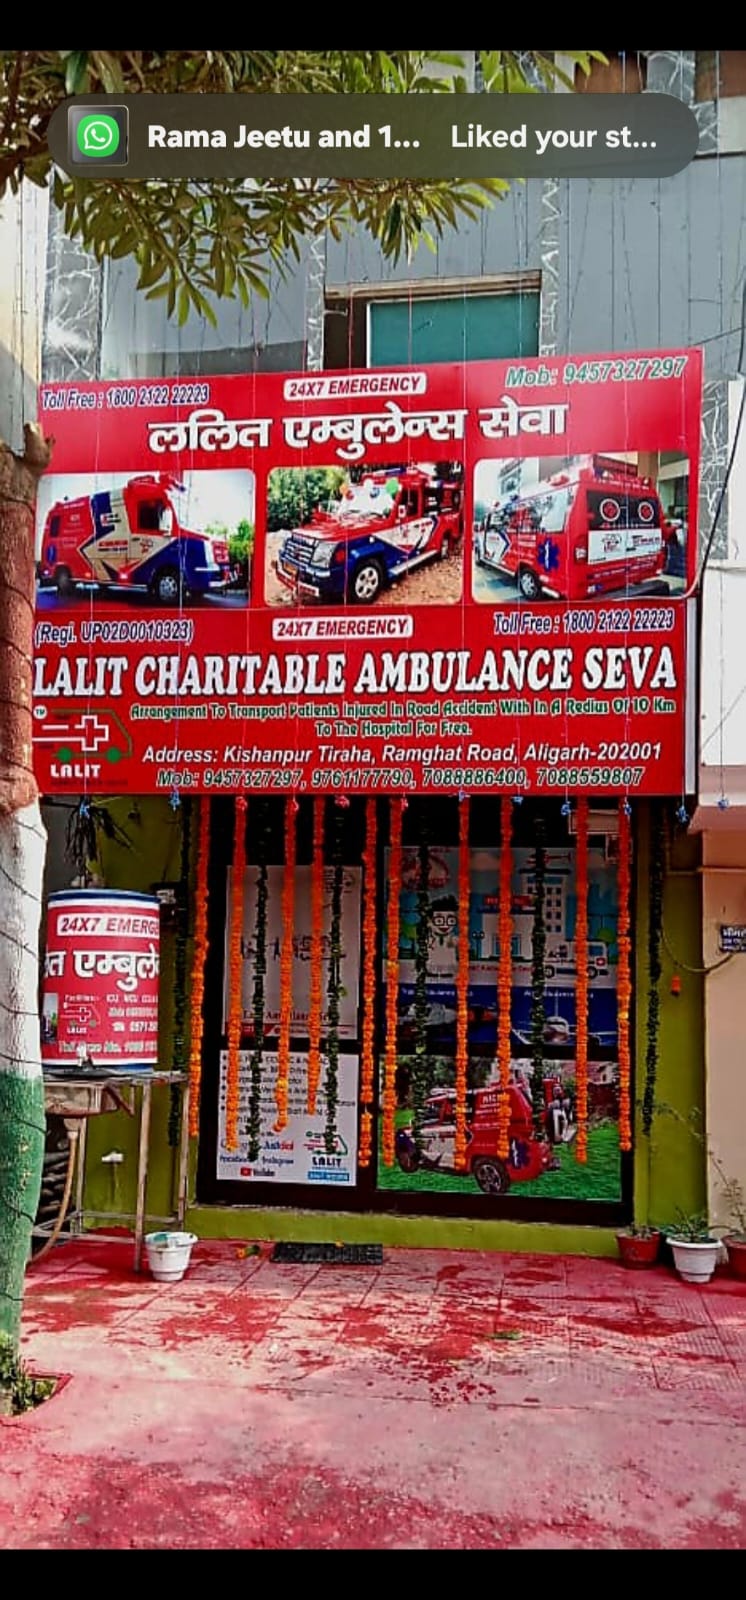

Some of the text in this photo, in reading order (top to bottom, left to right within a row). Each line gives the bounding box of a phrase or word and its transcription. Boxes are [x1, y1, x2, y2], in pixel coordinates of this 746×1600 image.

[505, 357, 687, 388] Mob: 9457327297
[42, 391, 65, 409] Toll
[68, 391, 96, 407] Free
[107, 388, 137, 407] 1800
[139, 387, 170, 406] 2122
[172, 385, 209, 404] 22223
[289, 376, 421, 397] 24X7 EMERGENCY
[148, 395, 569, 460] ललित एम्बुलेन्स सेवा
[277, 617, 408, 638] 24X7 EMERGENCY
[494, 613, 520, 632] Toll
[520, 612, 550, 632] Free
[563, 612, 593, 631] 1800
[597, 610, 630, 630] 2122
[633, 609, 675, 630] 22223
[32, 645, 677, 697] LALIT CHARITABLE AMBULANCE SEVA
[130, 698, 676, 721] Arrangement To Transport Patients Injured In Road Accident With In A Redius Of 10 Km
[315, 721, 473, 738] To The Hospital For Free.
[142, 742, 662, 766] Address: Kishanpur Tiraha, Ramghat Road, Aligarh-202001
[50, 764, 101, 778] LALIT
[156, 767, 645, 788] Mob: 9457327297, 9761177790, 7088886400, 7088559807
[61, 917, 101, 932] 24X7
